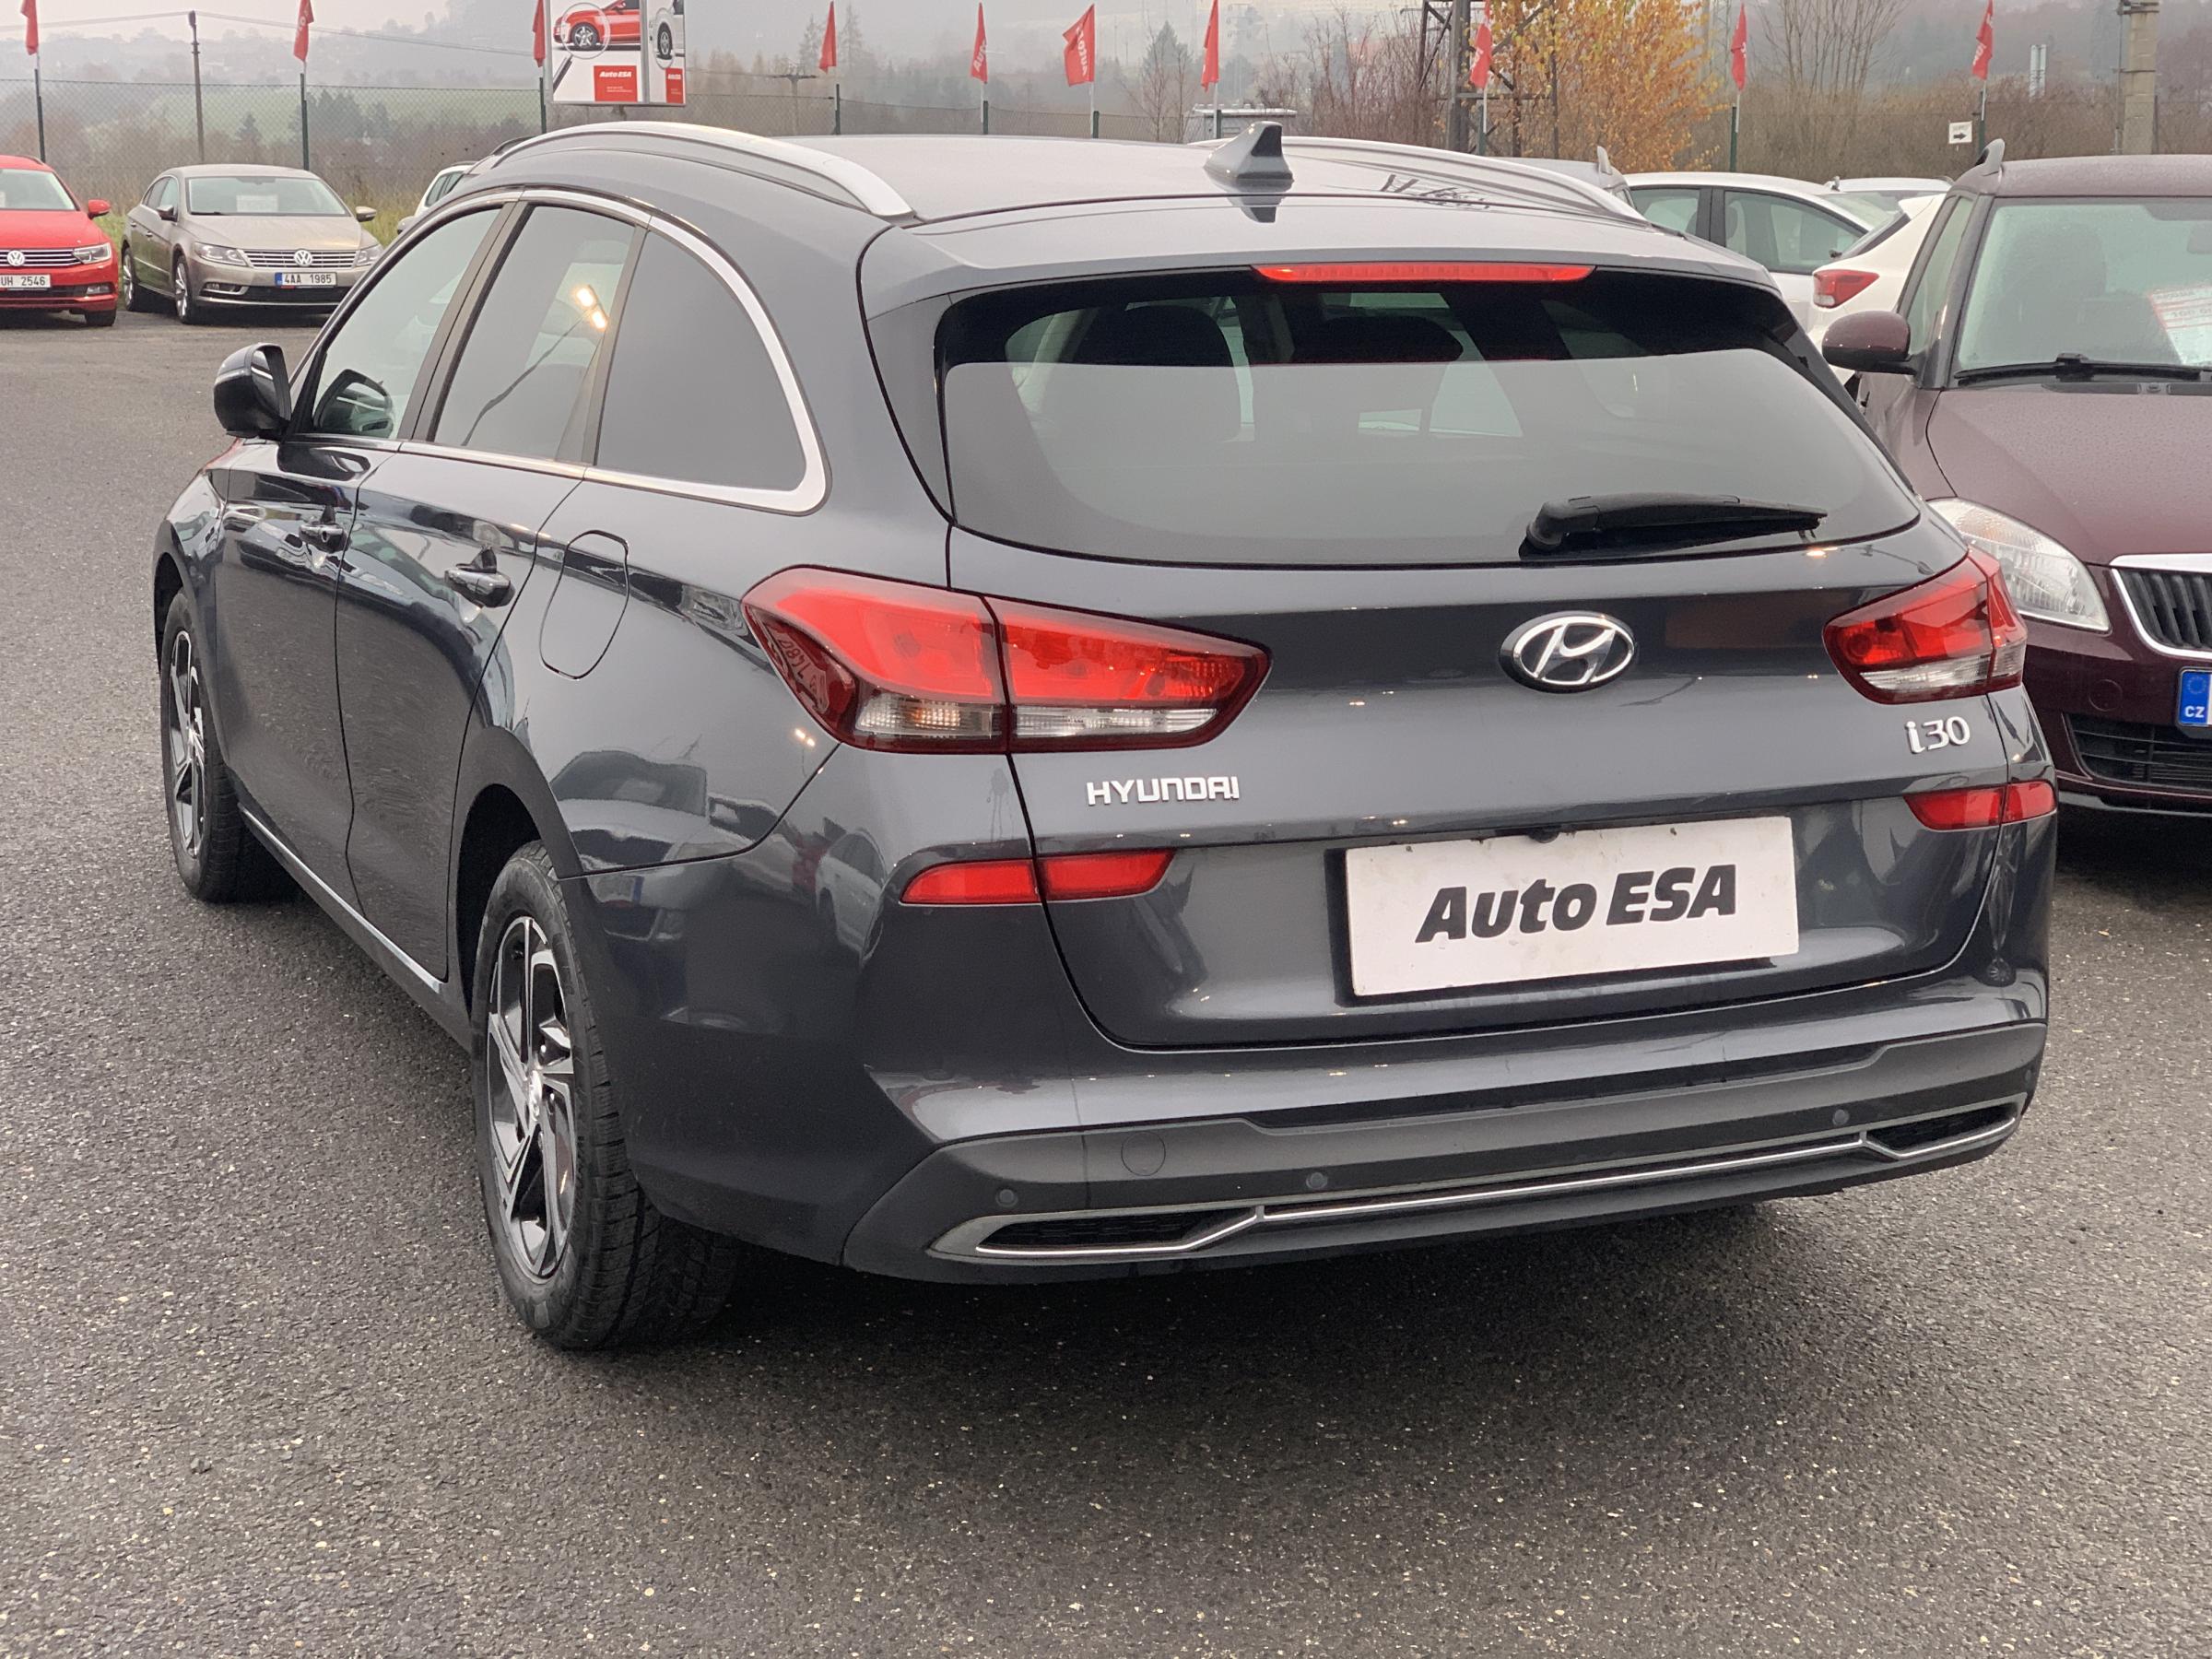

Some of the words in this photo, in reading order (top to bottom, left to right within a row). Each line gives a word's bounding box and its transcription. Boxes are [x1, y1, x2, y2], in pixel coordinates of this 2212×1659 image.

[21, 276, 46, 287] 2546
[284, 274, 302, 284] 4AA
[310, 274, 332, 284] 1985
[2184, 705, 2206, 718] CZ
[1904, 715, 1971, 755] i30
[1086, 775, 1240, 806] HYUNDAI
[1415, 878, 1597, 944] Auto
[1606, 864, 1736, 926] ESA
